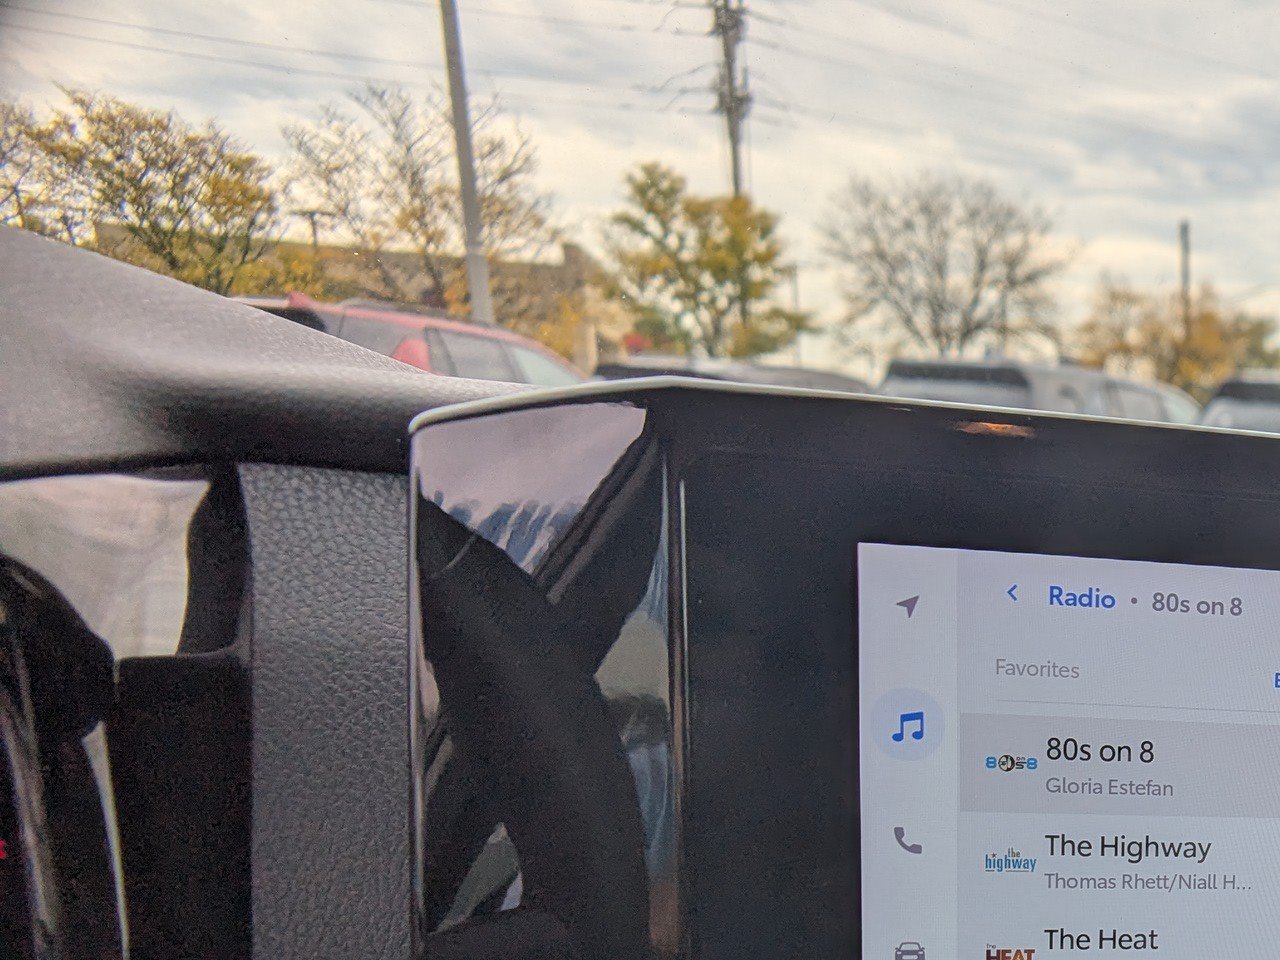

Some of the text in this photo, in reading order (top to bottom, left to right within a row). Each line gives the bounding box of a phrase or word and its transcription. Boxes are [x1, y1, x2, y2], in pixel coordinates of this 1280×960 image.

[1049, 584, 1243, 616] Radio 80s on 8
[995, 658, 1080, 680] Favorites
[1046, 737, 1155, 764] 80s on 8
[1045, 776, 1174, 798] Gloria Estefan
[1045, 834, 1212, 865] The Highway
[984, 853, 1037, 873] highway
[1044, 872, 1117, 891] Thomas
[1121, 873, 1218, 893] Rhett/Niall
[1044, 928, 1159, 951] The Heat
